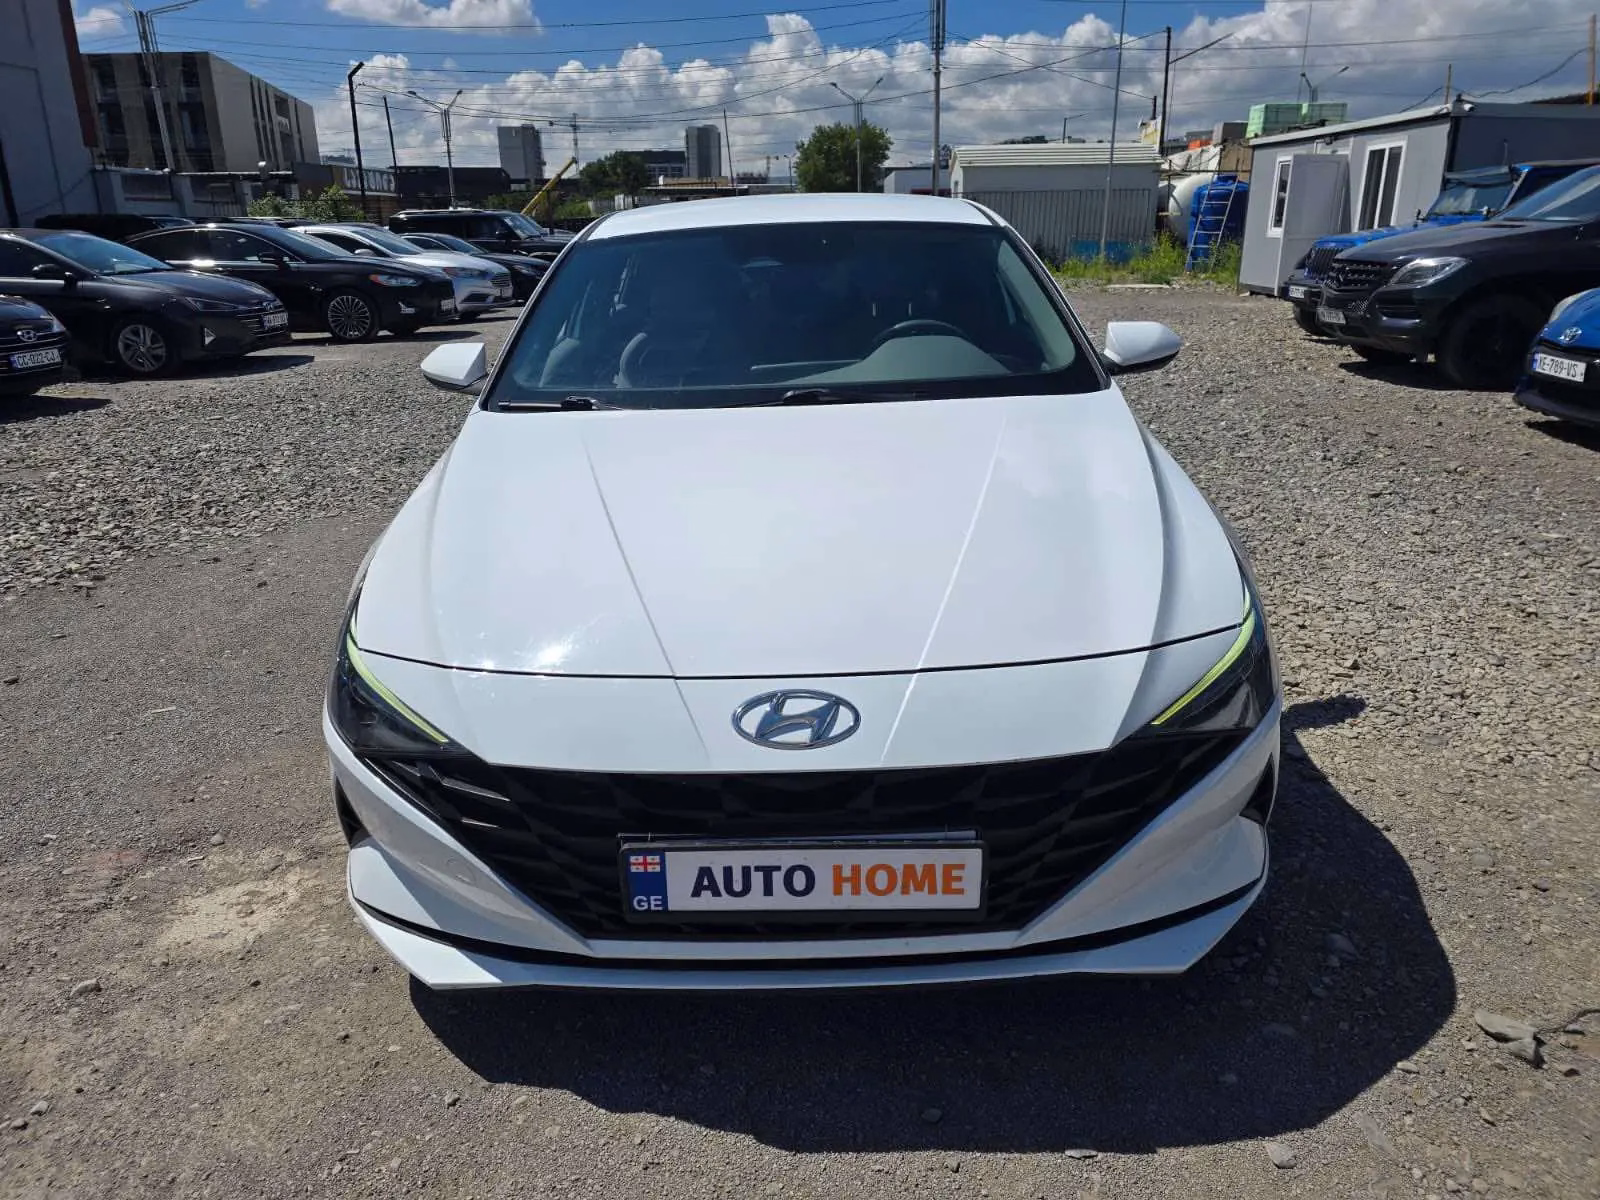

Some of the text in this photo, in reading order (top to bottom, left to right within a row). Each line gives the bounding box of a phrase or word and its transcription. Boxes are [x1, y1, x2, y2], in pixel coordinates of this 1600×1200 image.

[690, 863, 966, 898] AUTO HOME
[632, 895, 663, 911] GE
